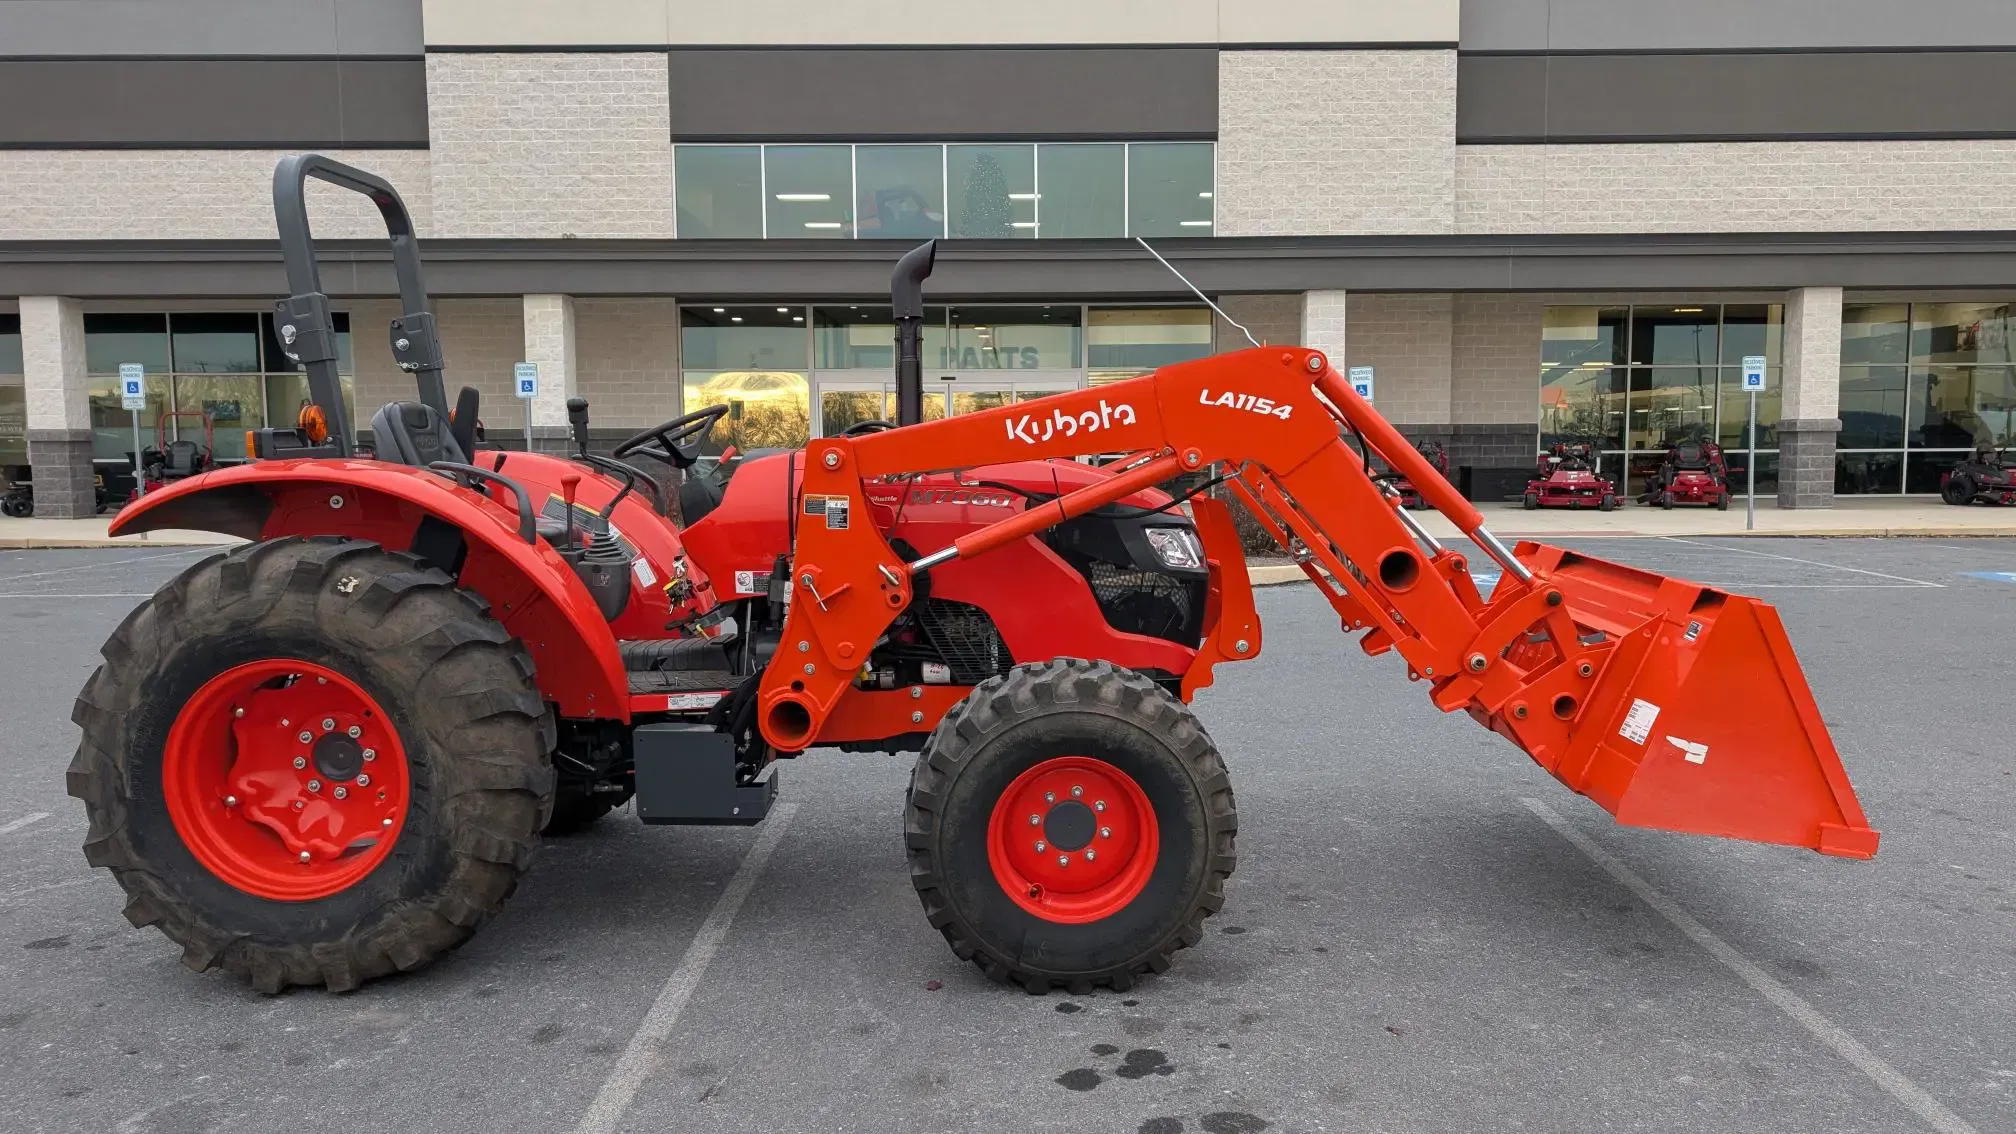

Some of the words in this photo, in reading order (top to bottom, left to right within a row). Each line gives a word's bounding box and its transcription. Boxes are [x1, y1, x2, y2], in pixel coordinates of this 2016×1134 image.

[940, 346, 1040, 369] PARTS
[1199, 389, 1293, 420] LA1154
[1005, 400, 1136, 445] Kubota
[911, 489, 1011, 507] M7060
